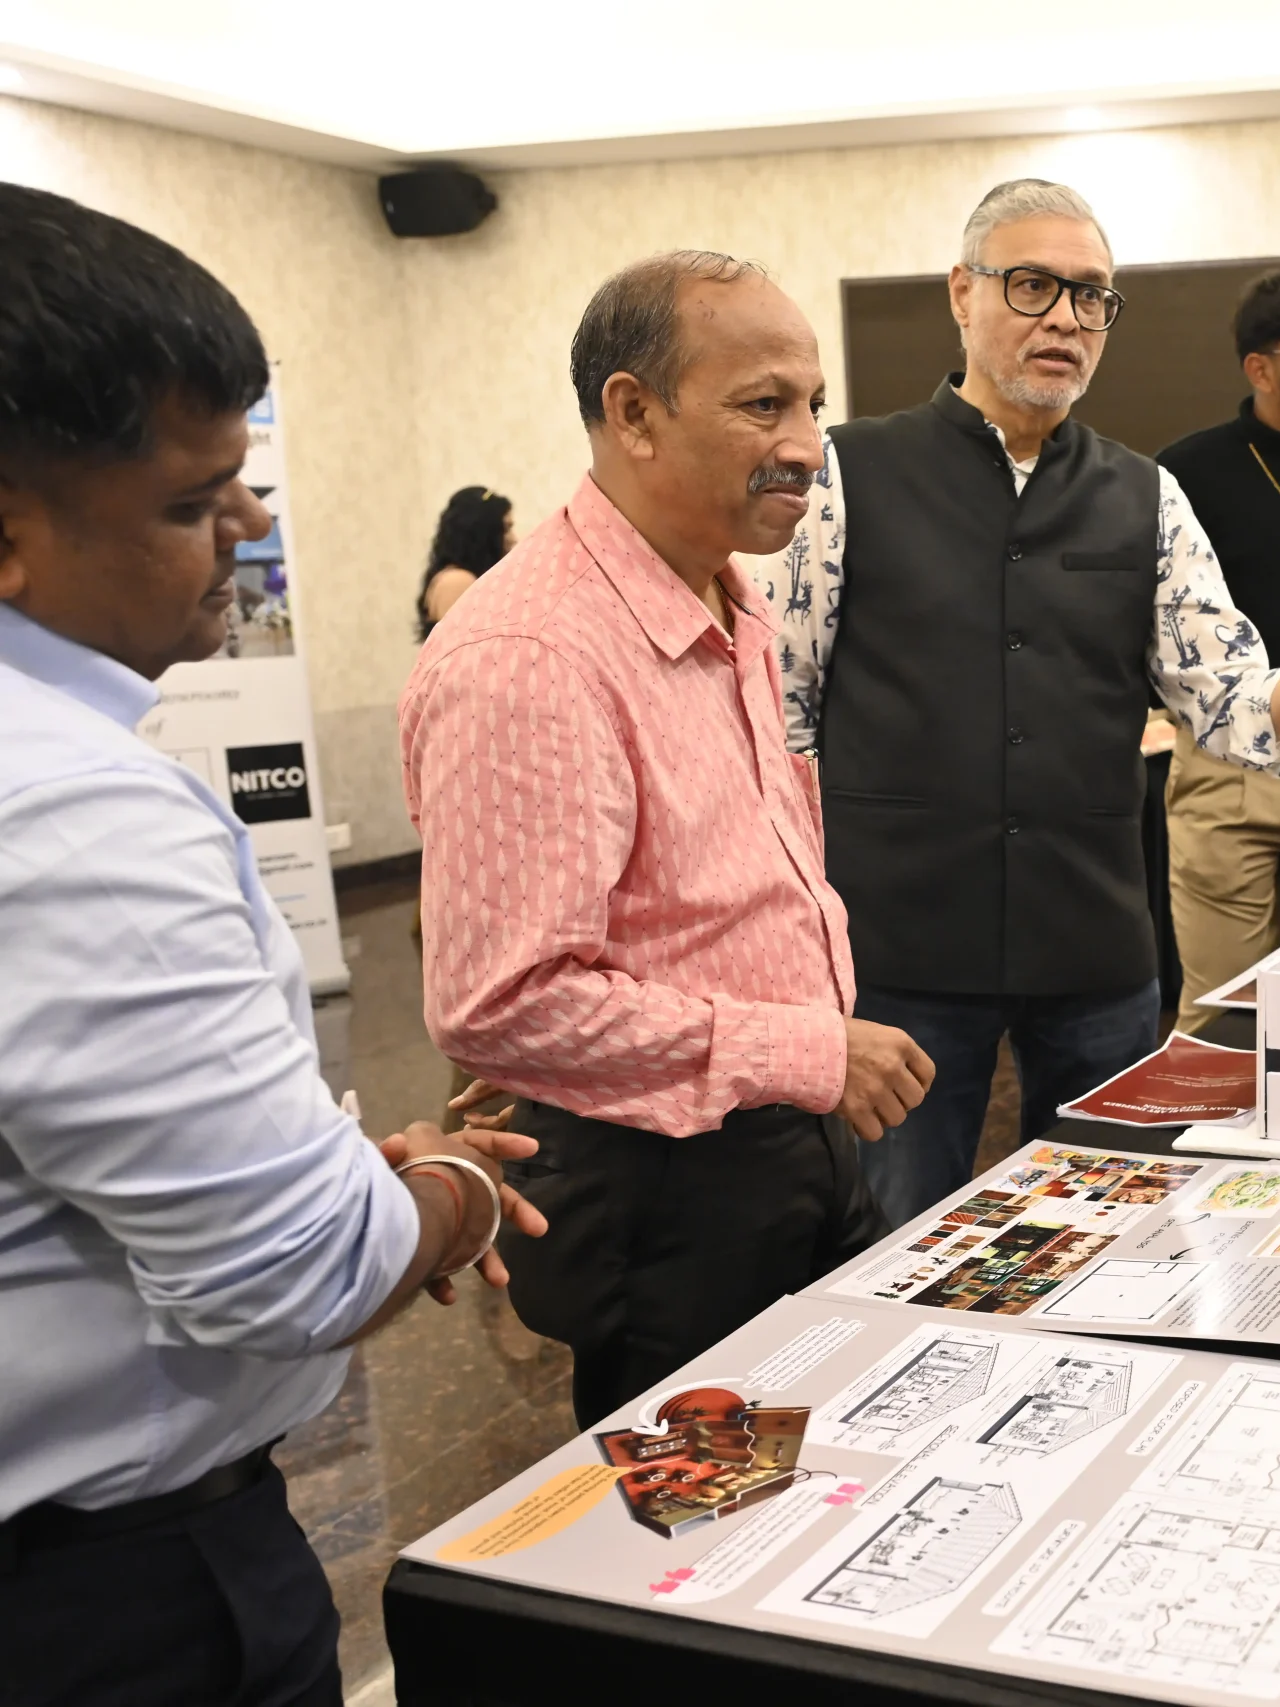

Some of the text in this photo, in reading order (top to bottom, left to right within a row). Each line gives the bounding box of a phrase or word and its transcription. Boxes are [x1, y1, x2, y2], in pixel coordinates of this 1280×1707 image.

[230, 766, 306, 793] NITCO
[1134, 1218, 1177, 1249] SITE ANALYSIS
[1132, 1382, 1201, 1453] PROPOSED FLOOR PLAN
[863, 1424, 962, 1505] SECTIONAL ELEVATION
